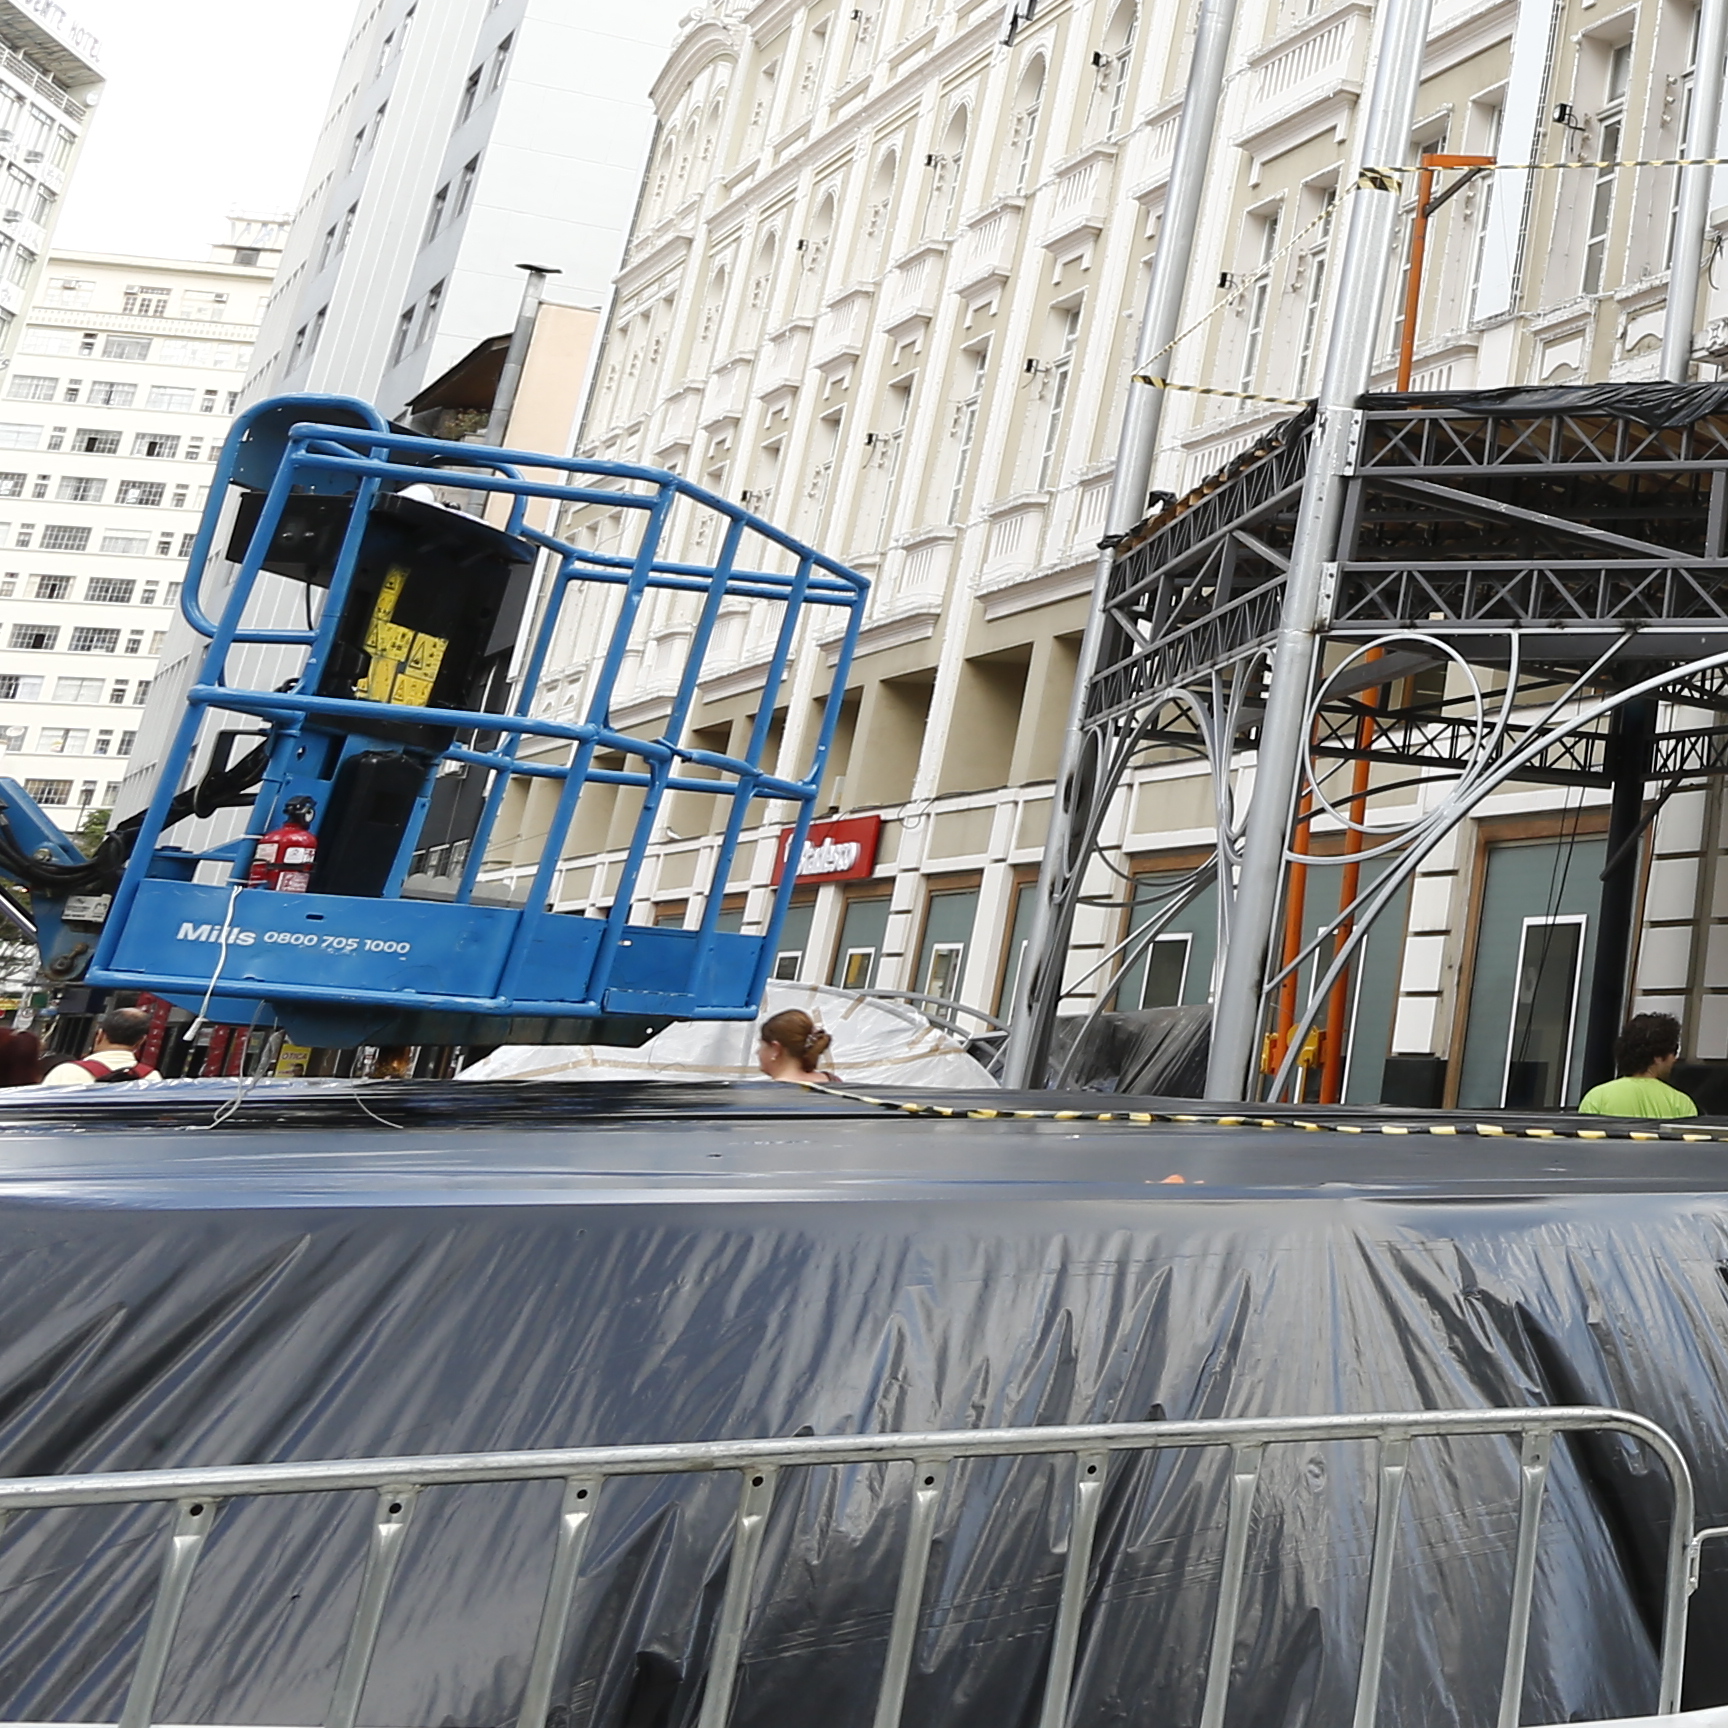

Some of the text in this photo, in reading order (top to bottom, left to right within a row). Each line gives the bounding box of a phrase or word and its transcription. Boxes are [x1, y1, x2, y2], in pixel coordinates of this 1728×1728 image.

[263, 931, 318, 947] 0800
[321, 935, 360, 951] 705
[363, 939, 411, 955] 1000
